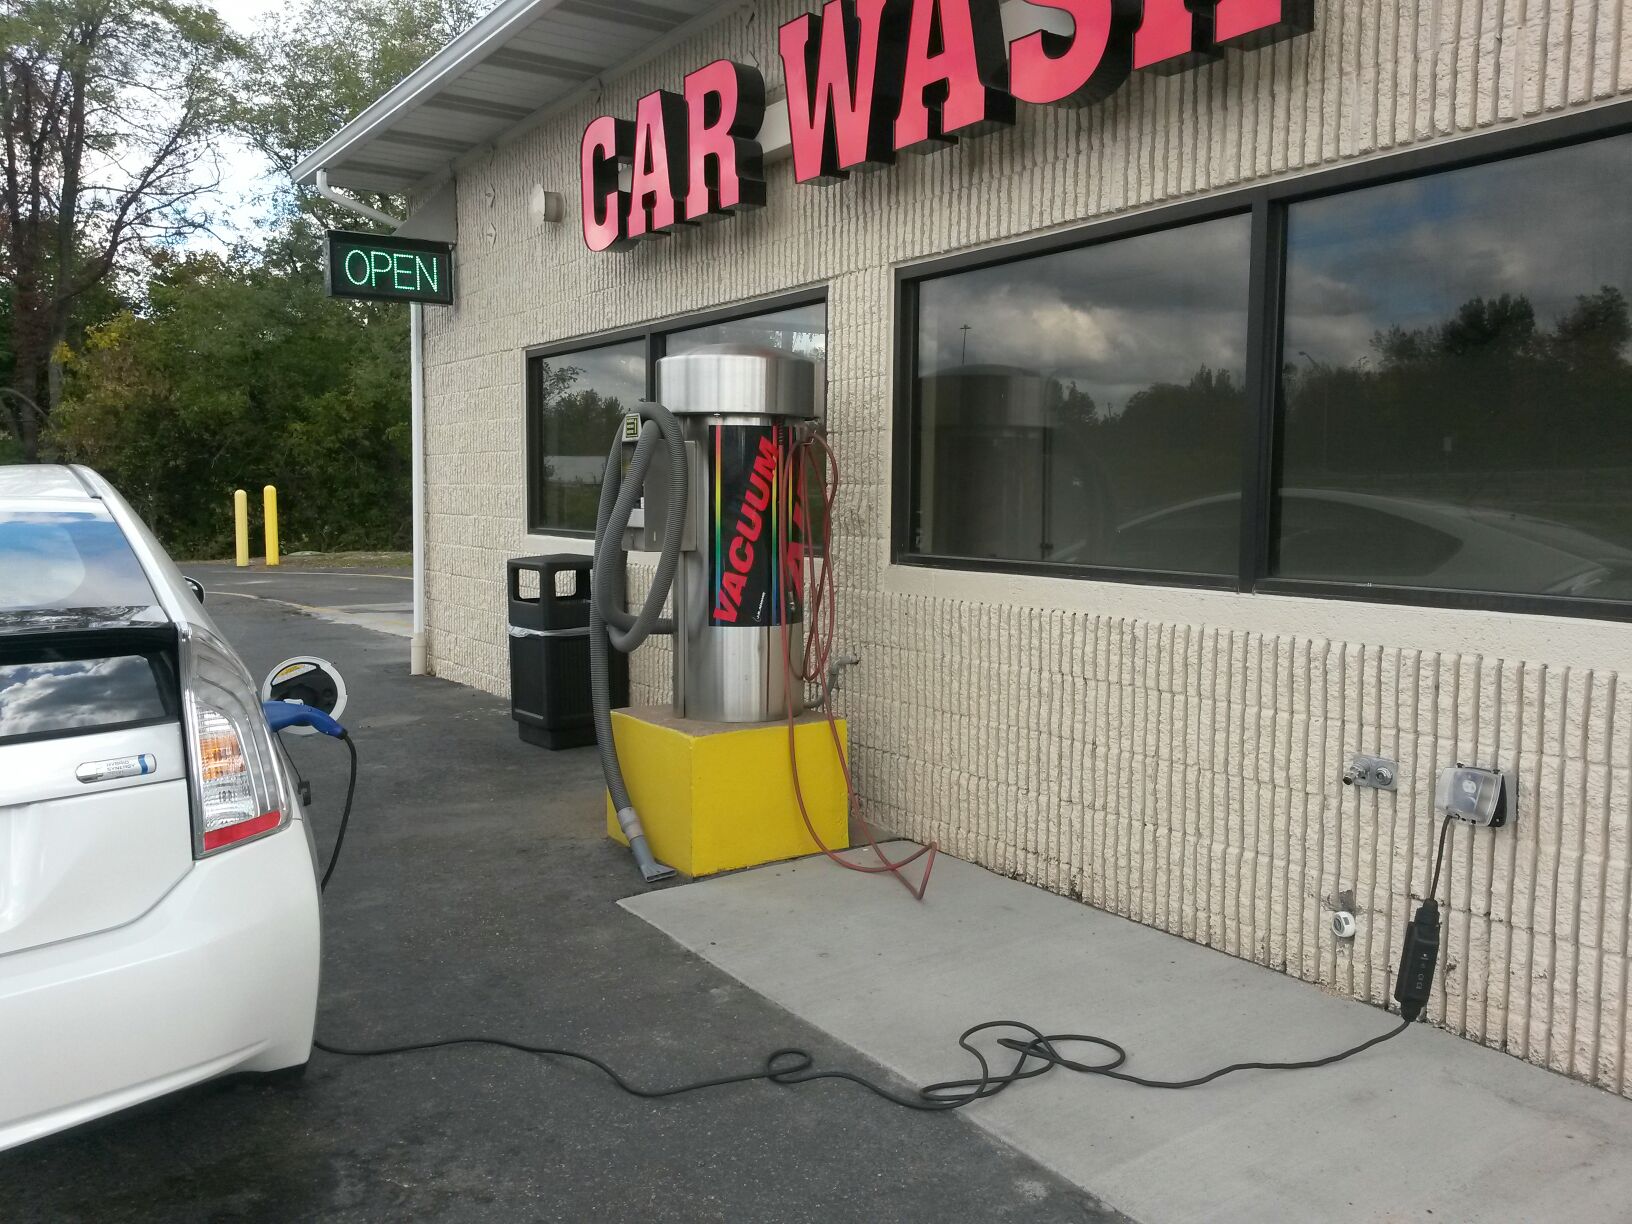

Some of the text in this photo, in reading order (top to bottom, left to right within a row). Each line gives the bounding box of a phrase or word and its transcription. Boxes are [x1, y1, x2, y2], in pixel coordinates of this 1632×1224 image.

[581, 59, 742, 252] CAR
[344, 249, 438, 292] OPEN
[713, 437, 780, 623] VACUUM
